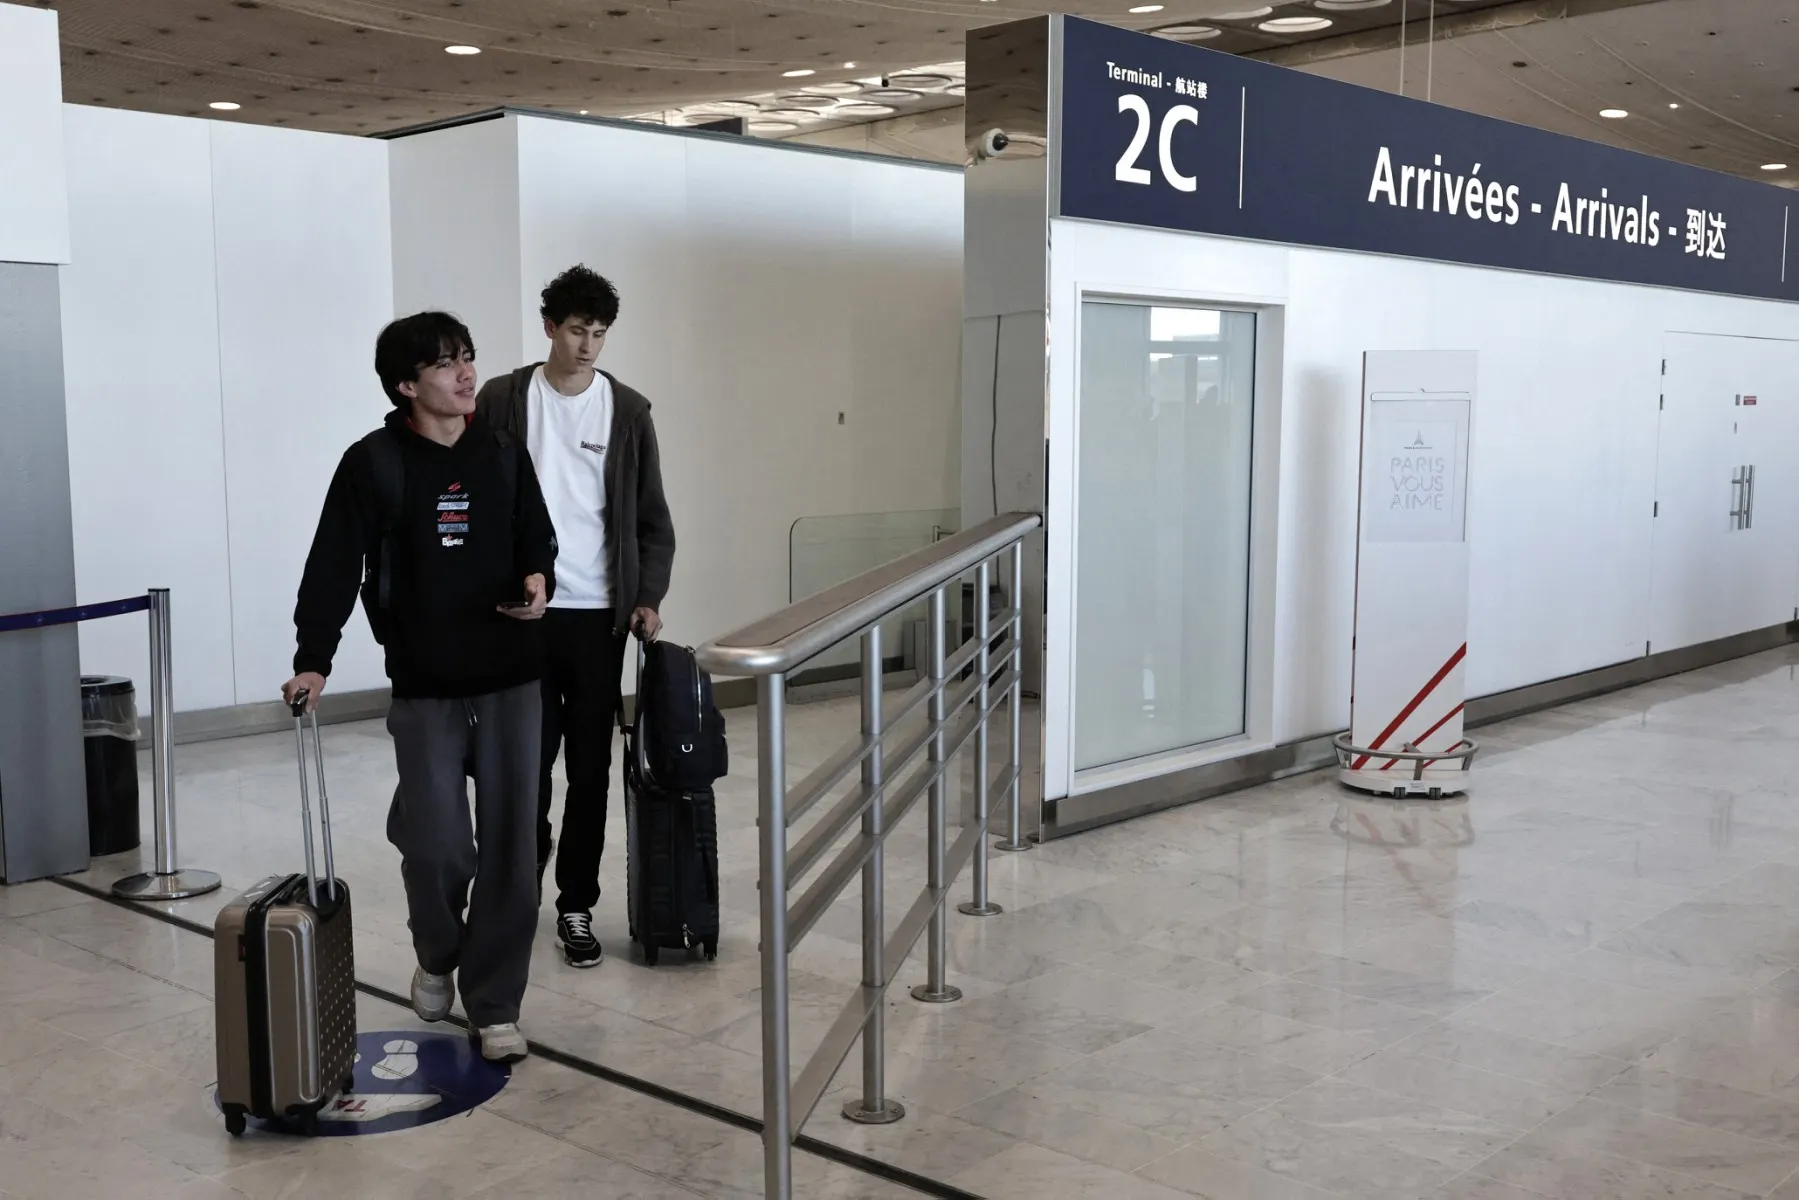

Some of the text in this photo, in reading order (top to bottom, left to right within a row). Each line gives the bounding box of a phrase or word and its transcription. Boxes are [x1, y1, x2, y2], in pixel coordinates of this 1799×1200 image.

[1106, 62, 1162, 88] Terminal
[1116, 94, 1198, 192] 2C
[1368, 147, 1519, 225] Arrivées
[1552, 182, 1659, 246] Arrivals
[1685, 208, 1726, 259] 到达
[1391, 457, 1444, 473] PARIS
[1391, 475, 1444, 492] VOUS
[1390, 493, 1444, 510] AIME
